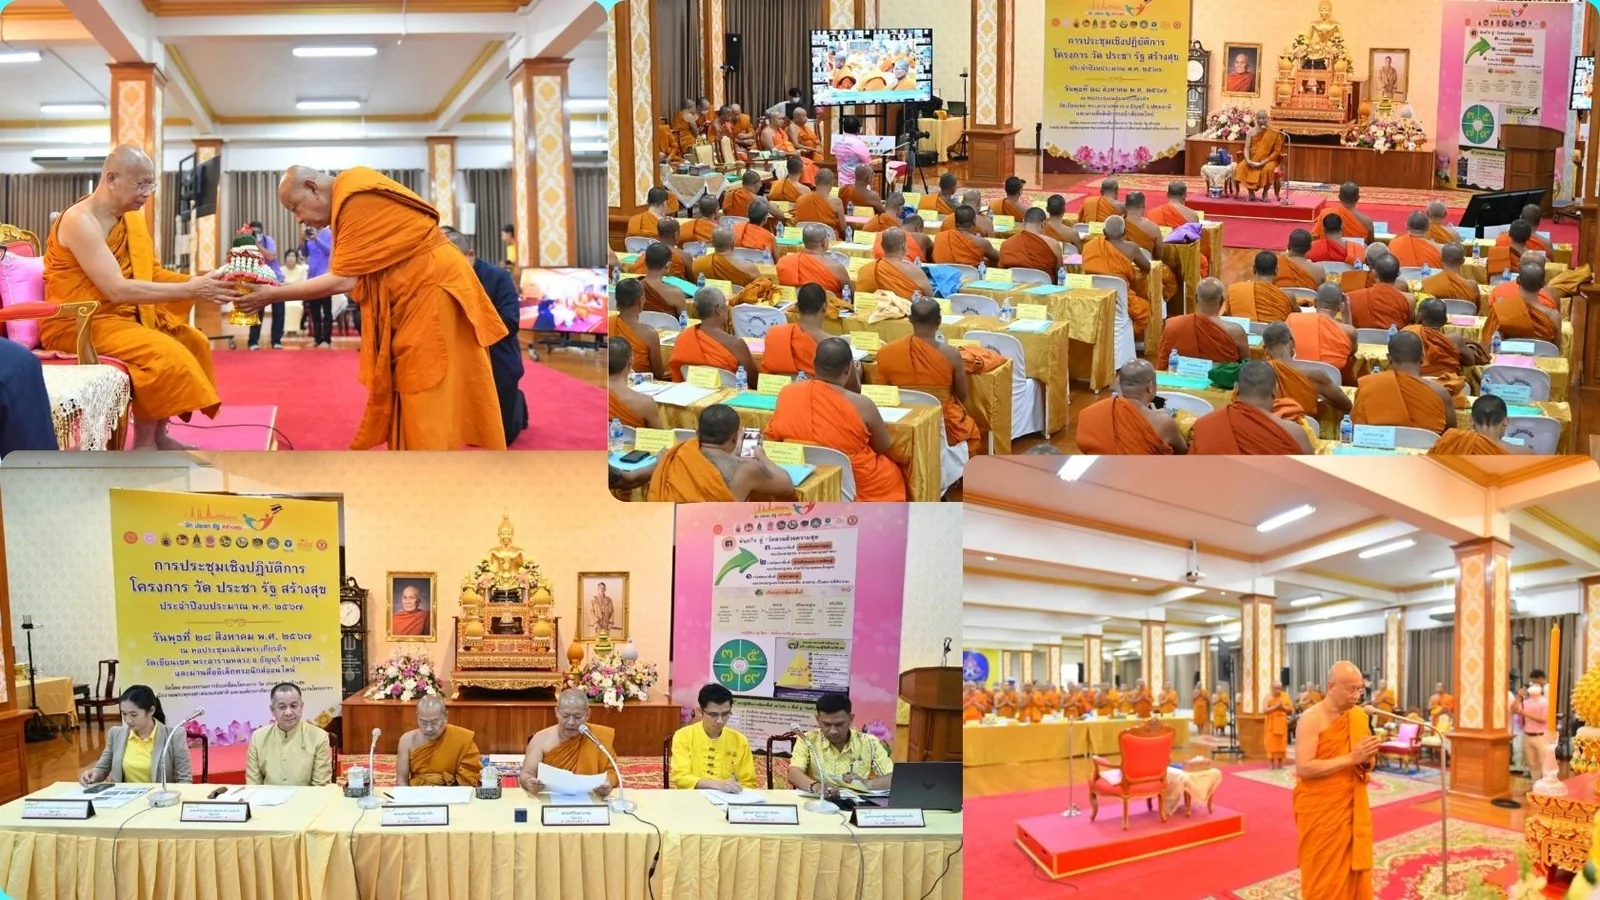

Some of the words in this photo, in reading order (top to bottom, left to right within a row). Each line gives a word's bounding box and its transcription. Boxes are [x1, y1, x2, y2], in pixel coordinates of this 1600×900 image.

[1068, 36, 1165, 48] การประชุมเชิงปฏิบัติการ
[1053, 49, 1088, 58] โครงการ
[1092, 51, 1102, 59] วัด
[1148, 52, 1179, 62] สร้างสุข
[154, 560, 305, 576] การประชุมเชิงปฏิบัติการ
[130, 578, 188, 593] โครงการ
[194, 581, 211, 593] วัด
[217, 582, 256, 594] ประชา
[262, 583, 276, 597] รัฐ
[282, 582, 326, 598] สร้างสุข
[160, 600, 248, 611] ประจำปีงบประมาณ
[251, 602, 271, 611] พ.ศ.
[274, 602, 303, 610] ๒๕๖๗
[152, 629, 191, 645] วันพุธที่
[215, 632, 254, 641] สิงหาคม
[257, 633, 277, 641] พ.ศ.
[282, 632, 312, 641] ๒๕๖๗
[721, 649, 733, 658] ๓
[747, 649, 760, 661] ๕
[720, 672, 733, 682] ๗
[744, 672, 760, 684] ๙
